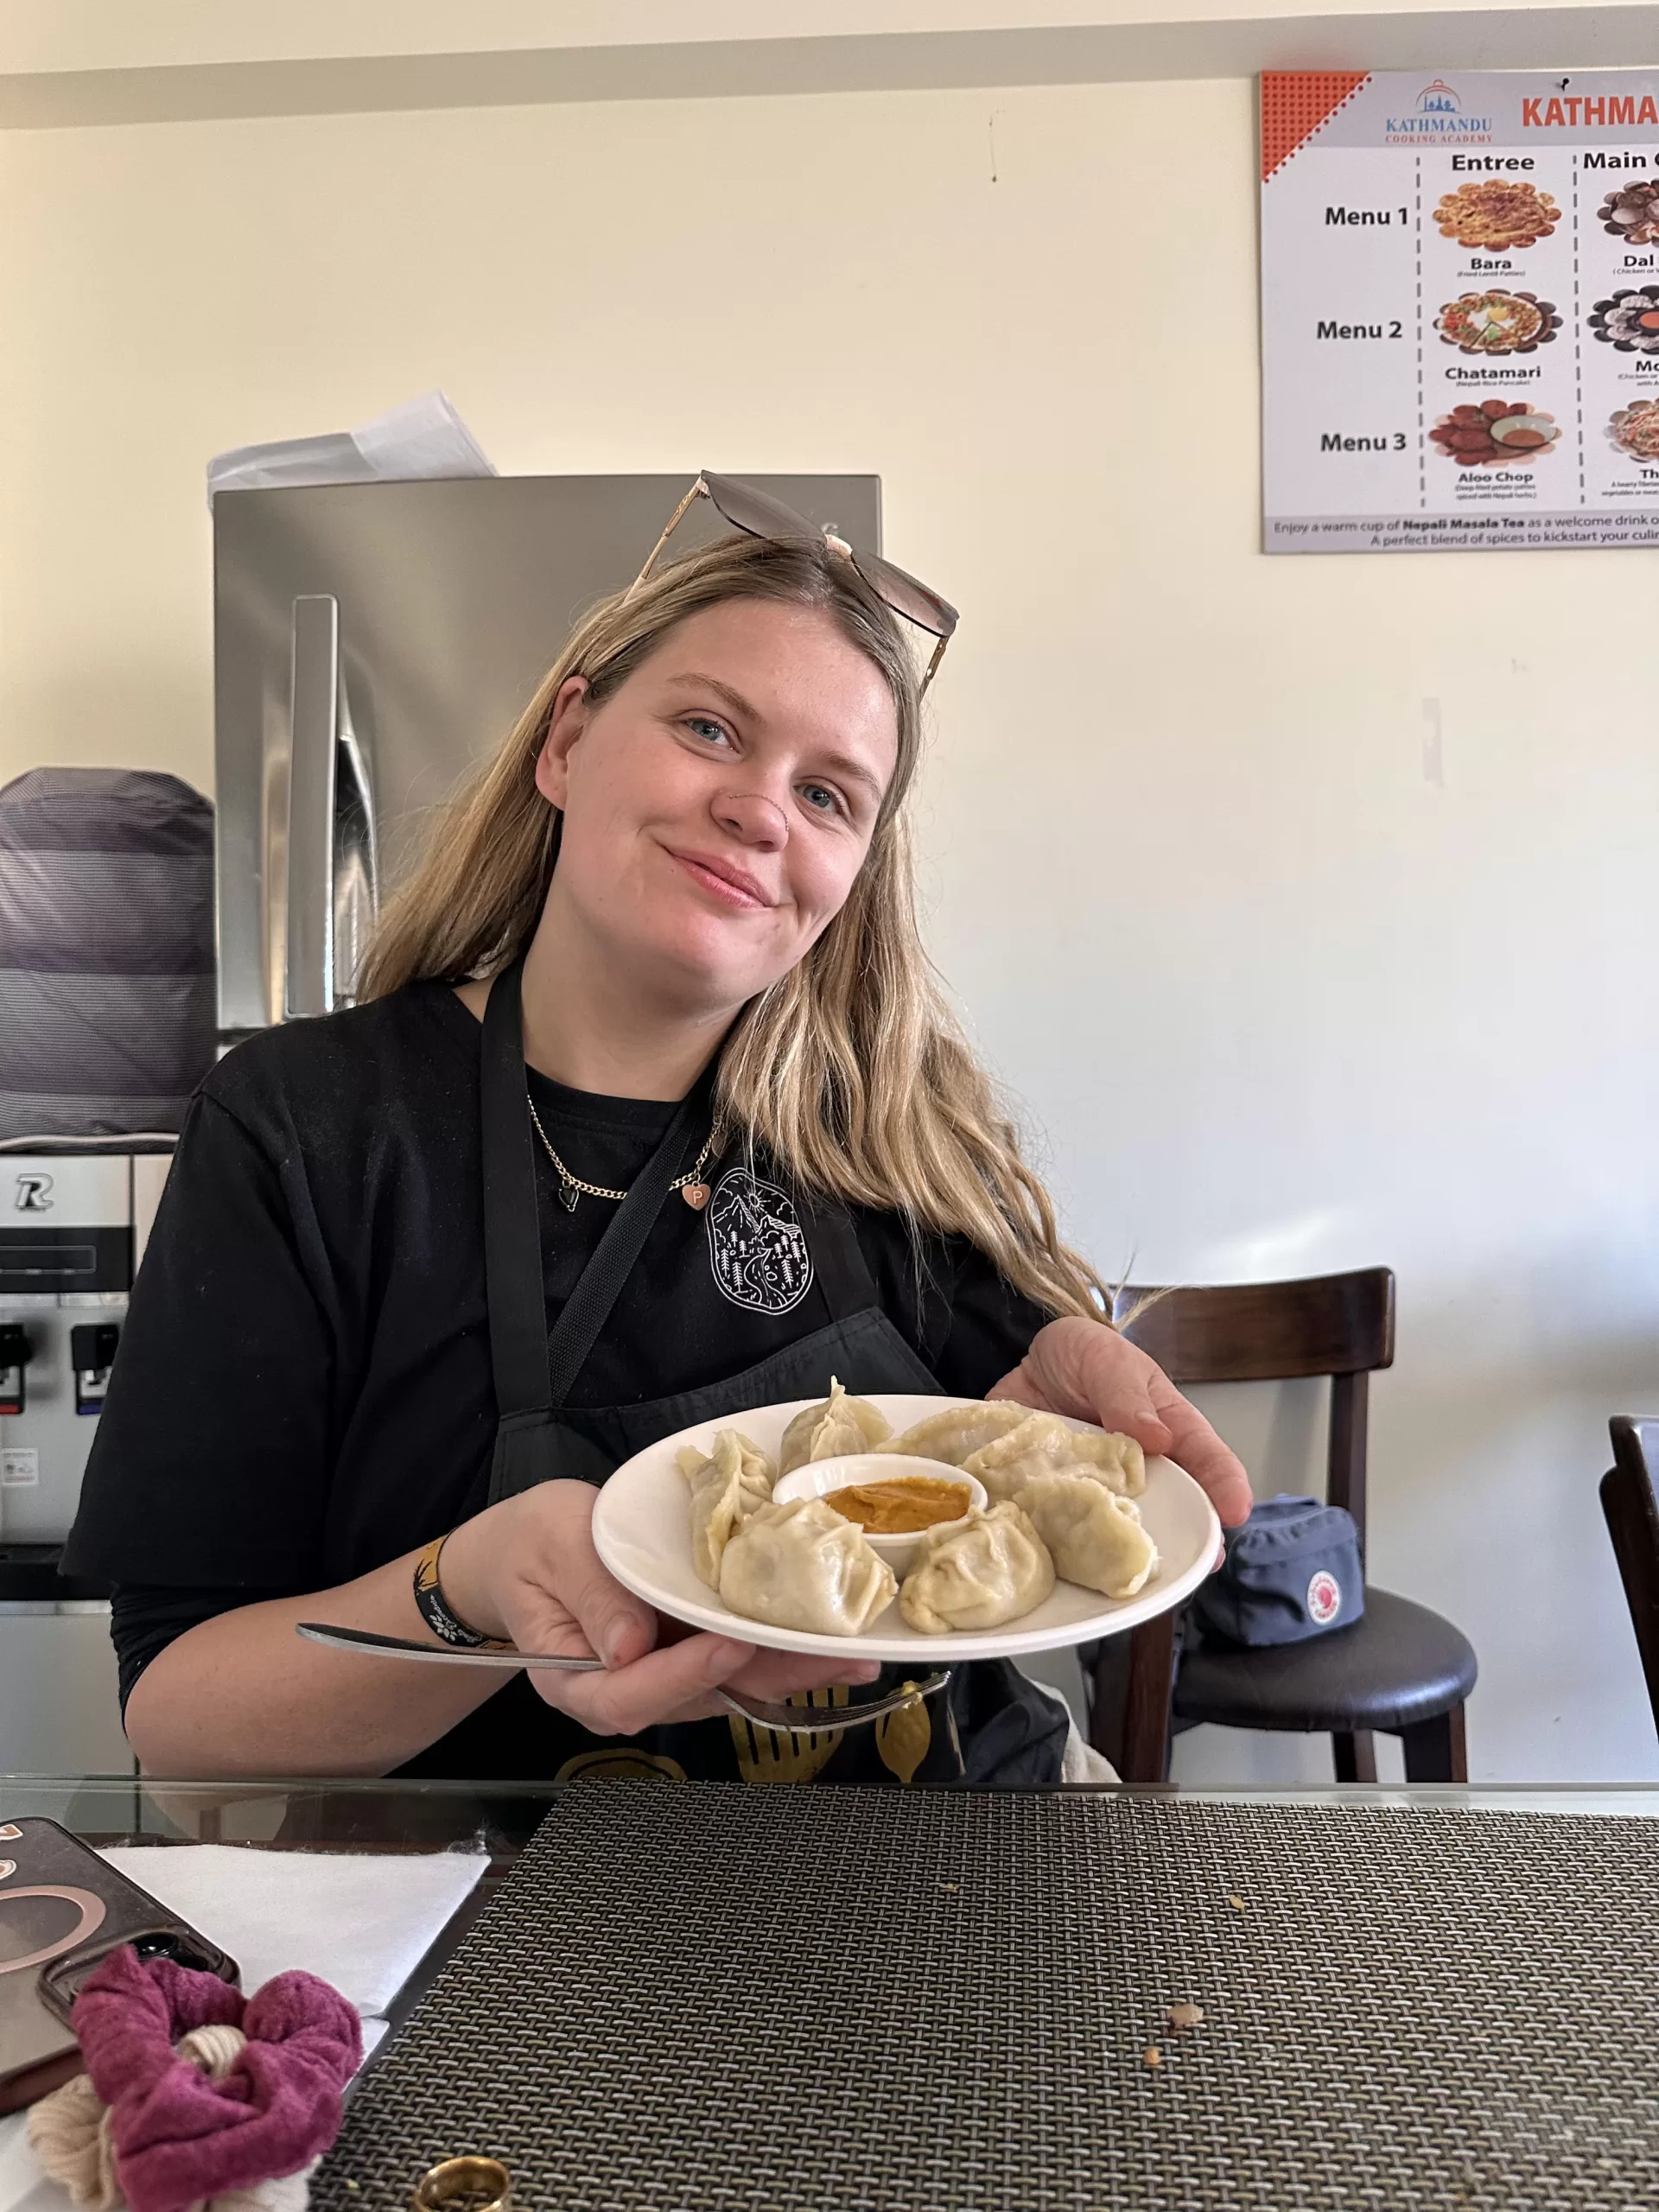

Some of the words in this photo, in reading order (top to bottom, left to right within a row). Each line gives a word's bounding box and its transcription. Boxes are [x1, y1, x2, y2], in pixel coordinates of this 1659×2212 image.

[1522, 96, 1659, 127] KATHMA
[1385, 118, 1492, 132] KATHMANDU
[1385, 135, 1436, 143] COOKING
[1440, 134, 1492, 143] ACADEMY
[1452, 155, 1535, 171] Entree
[1583, 151, 1647, 168] Main
[1325, 207, 1390, 226] Menu
[1398, 207, 1408, 225] 1
[1471, 257, 1511, 270] Bara
[1624, 254, 1654, 267] Dal
[1317, 321, 1382, 340] Menu
[1388, 321, 1402, 339] 2
[1445, 366, 1541, 379] Chatamari
[1320, 434, 1387, 453] Menu
[1392, 433, 1407, 451] 3
[1459, 473, 1492, 482] Aloo
[1495, 472, 1534, 483] Chop
[1639, 468, 1659, 479] Th
[1274, 522, 1309, 535] Enjoy
[1310, 524, 1319, 533] a
[1321, 523, 1357, 532] warm
[1359, 522, 1384, 535] cup
[1386, 520, 1402, 531] of
[1402, 518, 1447, 532] Nepali
[1450, 518, 1498, 530] Masala
[1500, 518, 1524, 529] Tea
[1527, 518, 1541, 528] as
[1544, 518, 1552, 528] a
[1554, 515, 1612, 527] welcome
[1615, 514, 1648, 526] drink
[1370, 536, 1381, 546] A
[1382, 535, 1427, 548] perfect
[1431, 534, 1468, 545] blend
[1470, 532, 1484, 544] of
[1486, 532, 1525, 545] spices
[1528, 533, 1541, 543] to
[1543, 531, 1597, 543] kickstart
[1600, 531, 1629, 543] your
[692, 1190, 703, 1205] P
